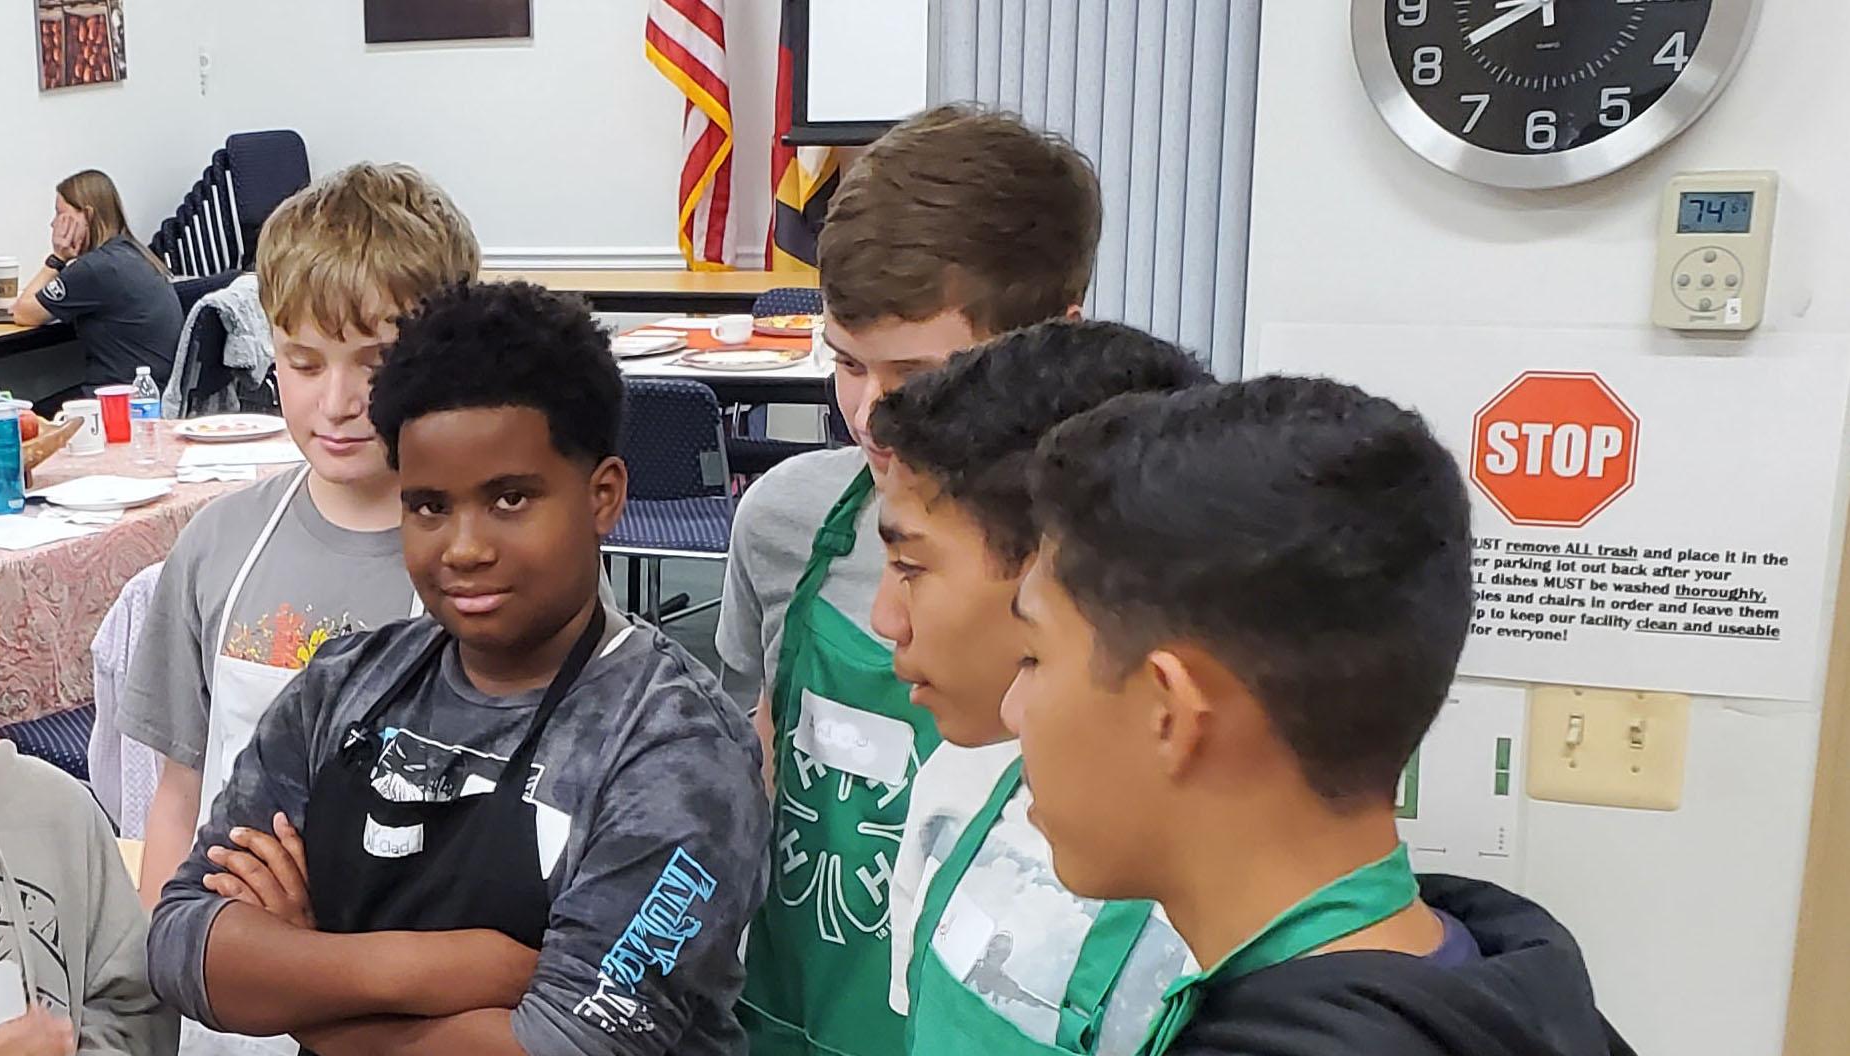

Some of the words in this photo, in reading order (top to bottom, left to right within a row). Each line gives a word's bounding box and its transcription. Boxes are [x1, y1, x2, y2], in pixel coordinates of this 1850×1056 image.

[1412, 46, 1443, 86] 8
[1652, 31, 1689, 72] 4
[1460, 94, 1491, 134] 7
[1598, 86, 1632, 128] 5
[1525, 110, 1558, 150] 6
[1689, 199, 1726, 223] 74
[1484, 421, 1623, 478] STOP
[1472, 538, 1501, 550] UST
[1506, 542, 1560, 553] remove
[1565, 543, 1592, 555] ALL
[1598, 544, 1637, 557] trash
[1643, 548, 1672, 559] and
[1678, 549, 1719, 563] place
[1725, 550, 1736, 563] it
[1742, 551, 1757, 564] in
[1763, 552, 1789, 566] the
[1491, 573, 1538, 587] dishes
[1544, 576, 1585, 590] MUST
[1590, 579, 1608, 592] be
[1613, 581, 1670, 595] washed
[1494, 558, 1552, 573] parking
[1556, 560, 1576, 572] lot
[1581, 562, 1606, 573] out
[1611, 563, 1647, 576] back
[1652, 566, 1690, 578] after
[1694, 569, 1731, 582] your
[1506, 592, 1534, 604] and
[1539, 595, 1586, 608] chairs
[1591, 596, 1605, 609] in
[1611, 598, 1653, 612] order
[1658, 602, 1687, 615] and
[1693, 603, 1733, 617] leave
[1739, 606, 1779, 620] them
[1470, 623, 1492, 636] for
[1497, 627, 1568, 641] everyone!
[1491, 608, 1504, 620] to
[1510, 608, 1544, 624] keep
[1550, 613, 1576, 624] our
[1581, 613, 1631, 631] facility
[1636, 617, 1677, 631] clean
[1683, 621, 1712, 633] and
[1718, 623, 1780, 638] useable
